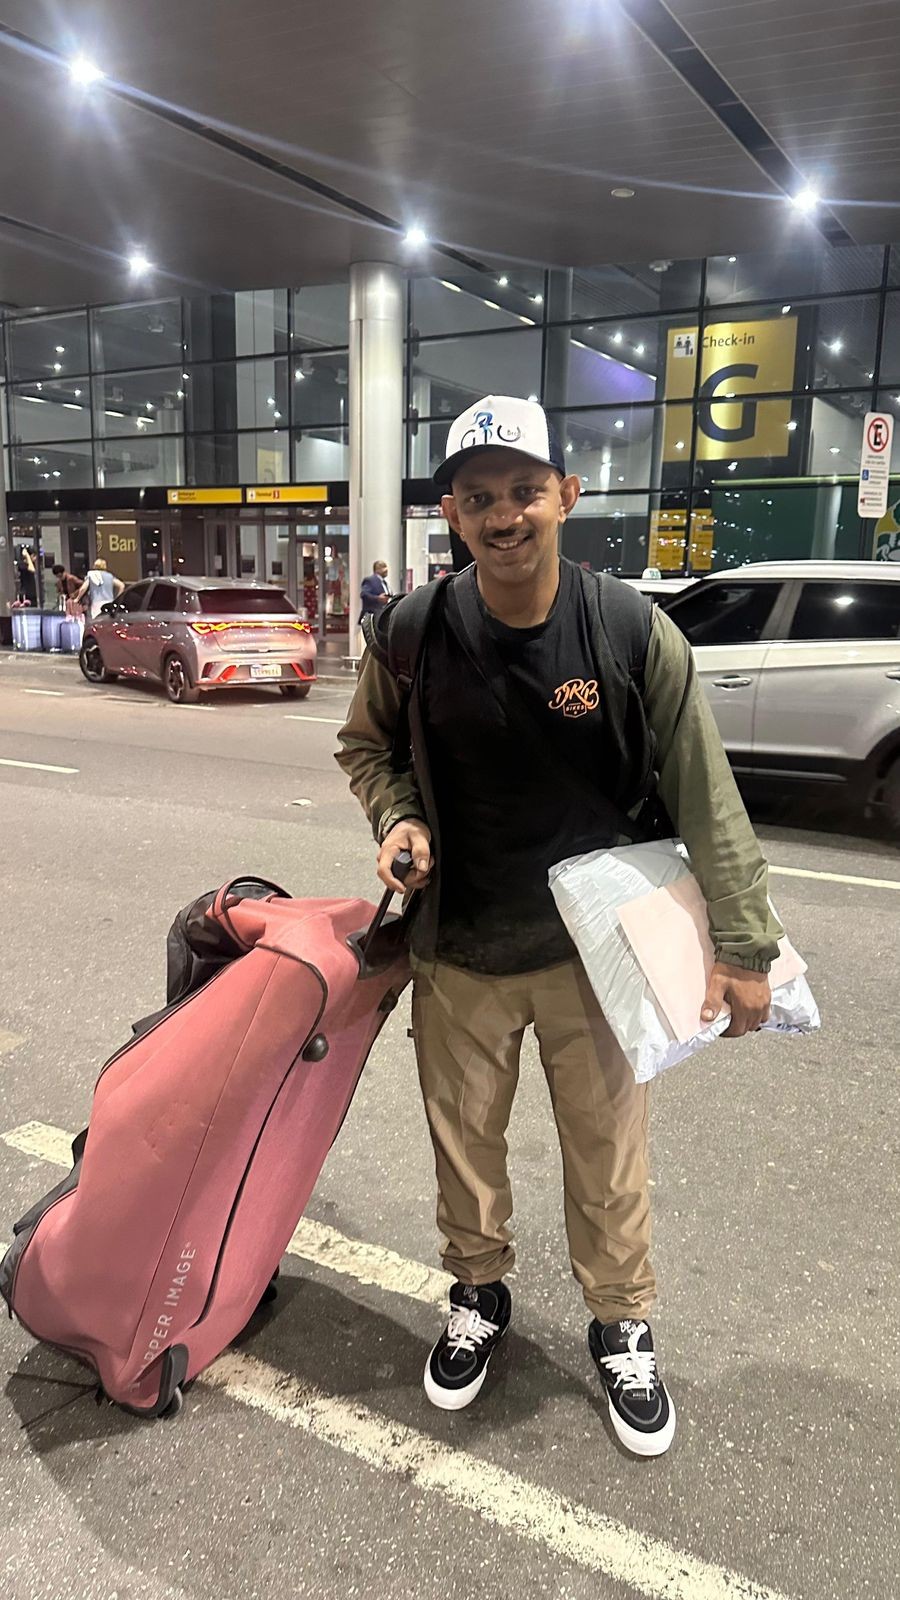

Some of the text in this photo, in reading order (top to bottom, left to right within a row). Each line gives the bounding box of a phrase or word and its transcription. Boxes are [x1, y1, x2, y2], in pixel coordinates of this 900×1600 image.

[702, 332, 755, 348] Check-in
[697, 363, 759, 443] G
[548, 678, 600, 710] DRB
[164, 1247, 196, 1306] IMAGE
